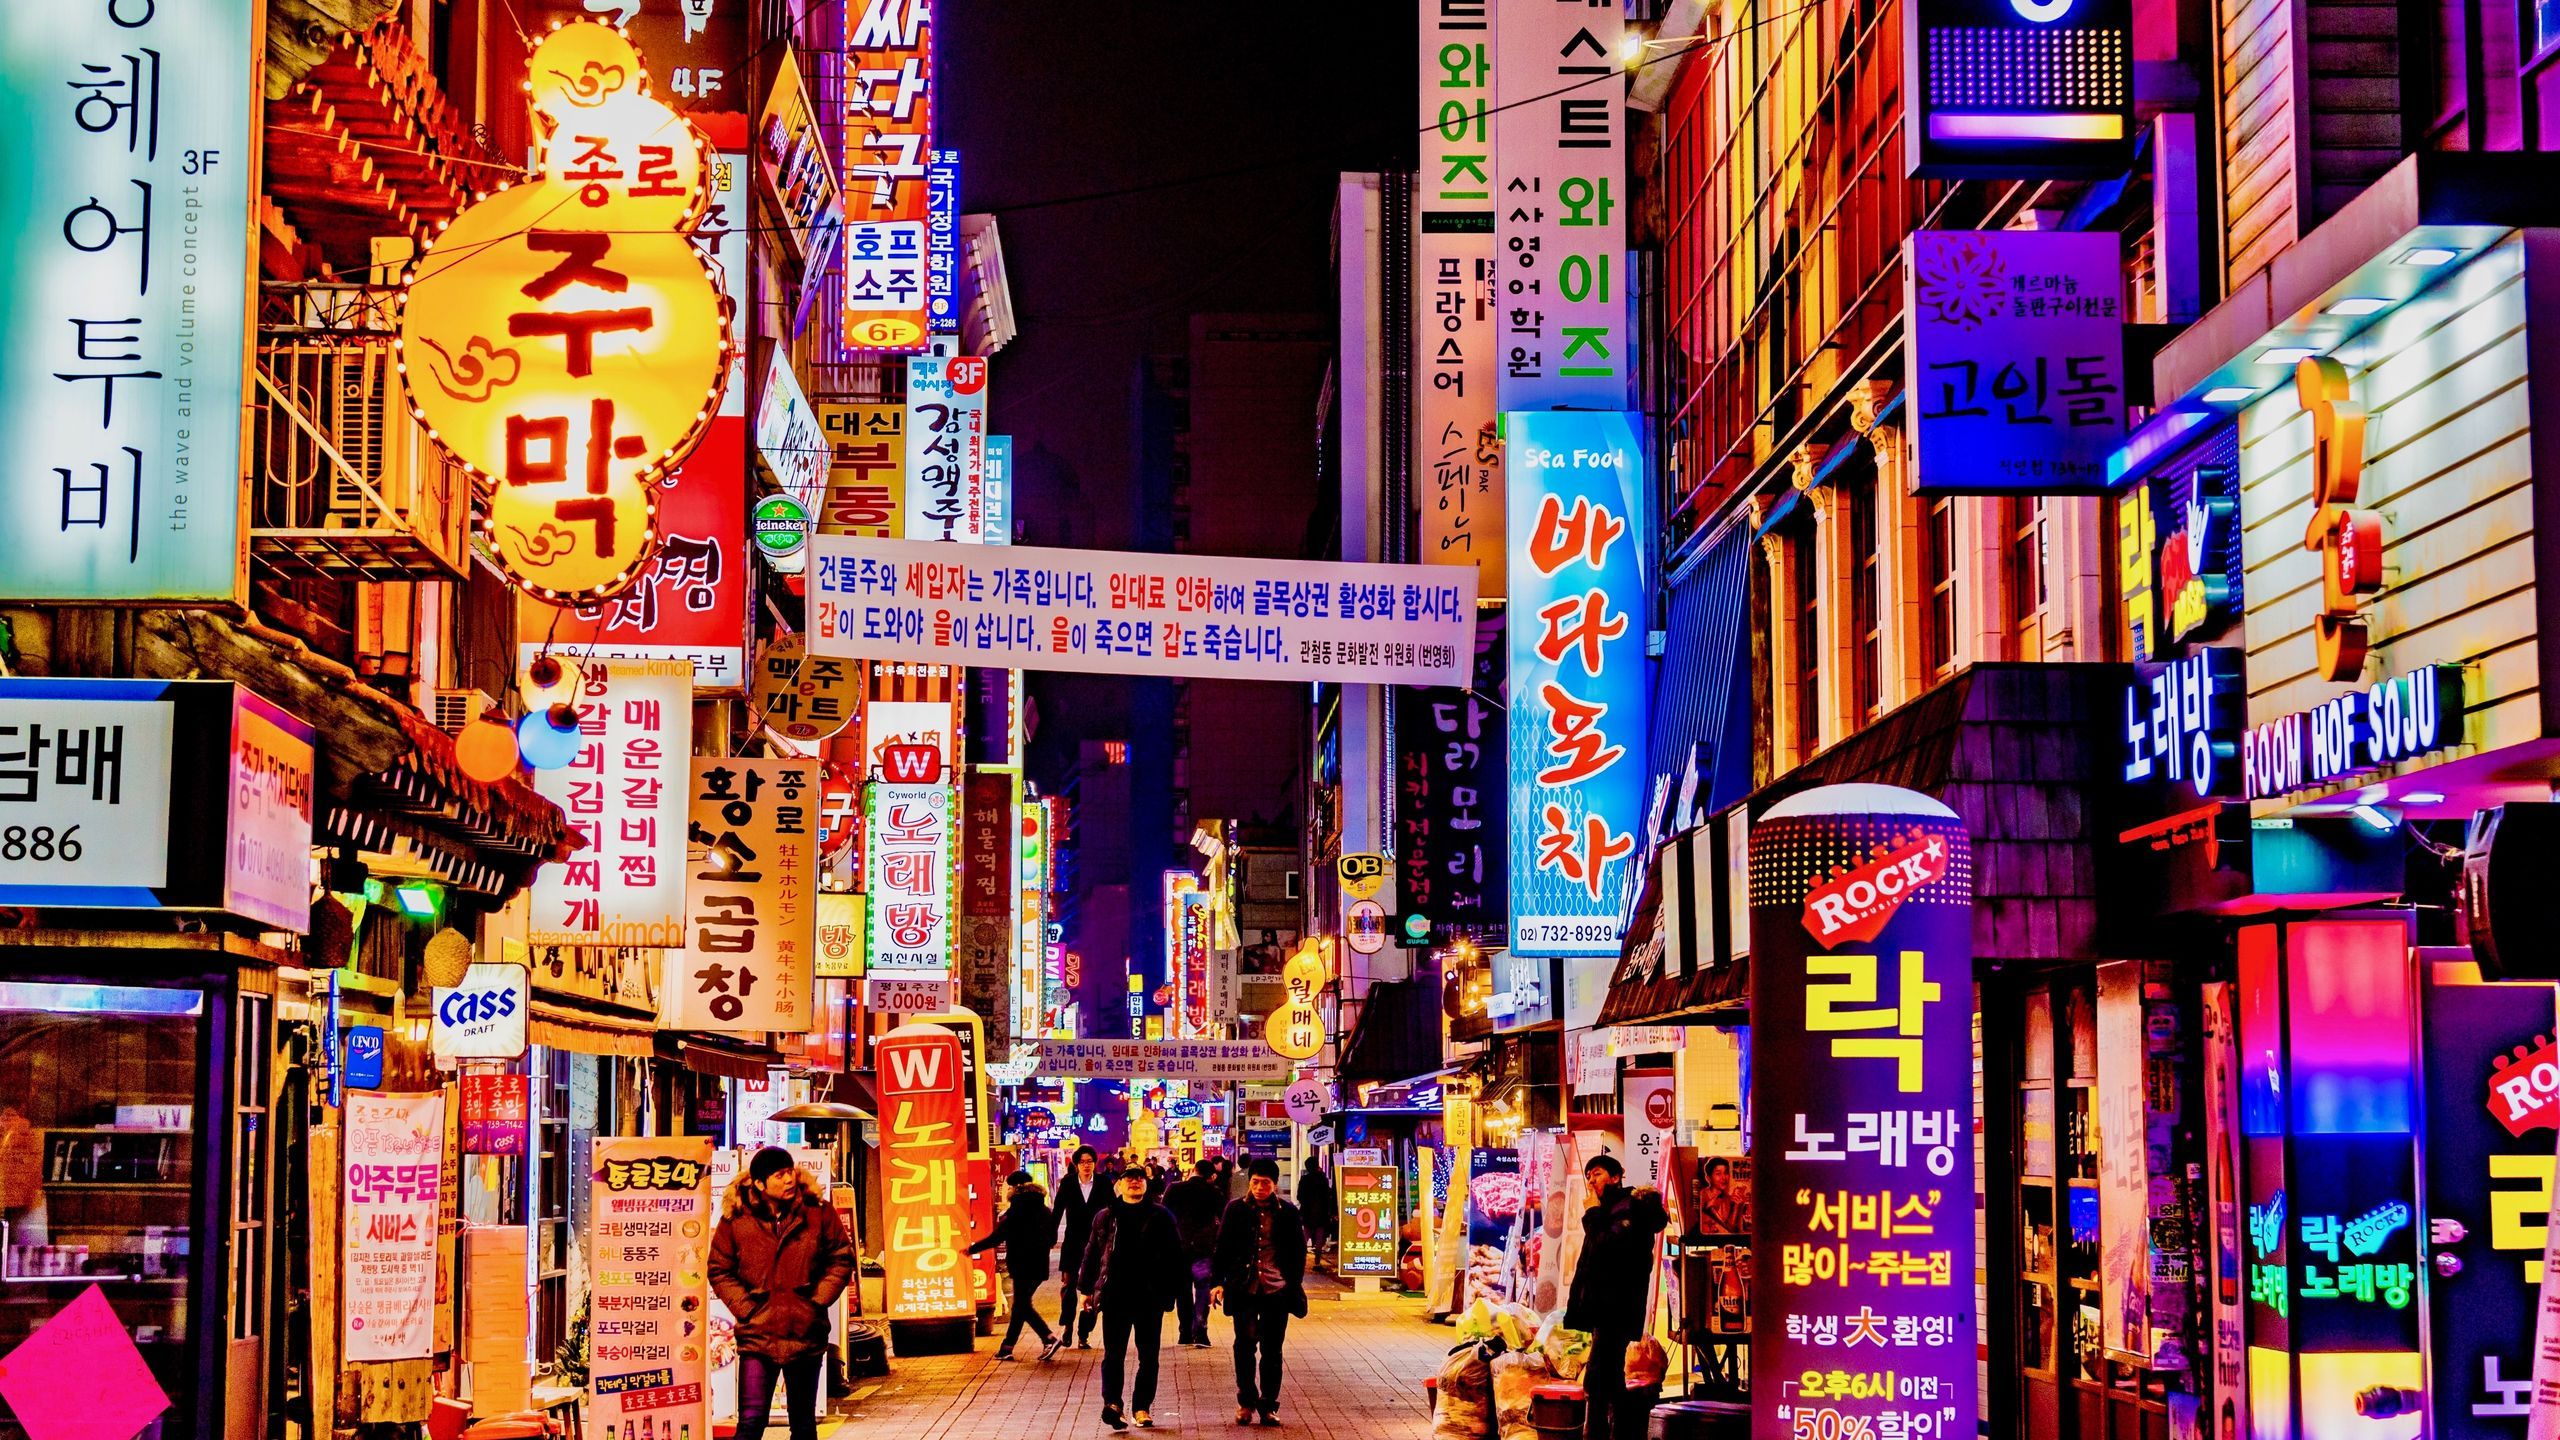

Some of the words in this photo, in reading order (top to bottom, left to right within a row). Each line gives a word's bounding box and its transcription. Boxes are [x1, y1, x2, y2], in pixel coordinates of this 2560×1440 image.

[671, 67, 724, 98] 4F
[850, 0, 931, 208] 싸다구
[181, 150, 220, 175] 3F
[564, 135, 686, 208] 종로
[183, 185, 201, 277] concept
[853, 227, 919, 261] 호프
[929, 168, 954, 297] 국가정보학원
[852, 269, 918, 304] 소주
[1507, 177, 1545, 378] 시사영어학원
[2011, 274, 2079, 295] 게르마늄
[179, 279, 196, 367] volume
[2012, 296, 2119, 318] 돌판구이전문
[868, 322, 907, 342] 6F
[1434, 258, 1466, 397] 프랑스어
[912, 362, 938, 379] 맥주
[912, 379, 955, 398] 야시장
[953, 363, 984, 385] 3F
[178, 378, 193, 418] and
[505, 228, 653, 559] 주막
[1922, 356, 2118, 427] 고인돌
[825, 411, 901, 436] 대신
[175, 438, 191, 485] wave
[1524, 448, 1566, 469] Sea
[1572, 448, 1624, 469] Food
[1433, 420, 1471, 553] 스페인어
[170, 494, 187, 532] the
[819, 554, 898, 598] 건물주와
[905, 561, 984, 603] 세입자는
[993, 566, 1097, 610] 가족입니다.
[1109, 572, 1166, 611] 임대료
[1176, 575, 1246, 616] 인하하여
[1252, 579, 1330, 619] 골목상권
[1338, 581, 1396, 622] 활성화
[1402, 584, 1463, 624] 합시다.
[2119, 484, 2156, 660] 락
[818, 601, 854, 641] 갑이
[862, 605, 924, 646] 도와야
[932, 607, 969, 649] 을이
[974, 612, 1042, 653] 삽니다.
[1050, 615, 1087, 655] 을이
[1094, 618, 1153, 658] 죽으면
[1299, 639, 1332, 666] 관철동
[1336, 641, 1379, 667] 문화발전
[1383, 643, 1415, 668] 위원회
[1418, 644, 1456, 669] (번영회)
[767, 657, 845, 689] 맥주
[766, 693, 842, 722] 마트
[1528, 492, 1635, 902] 바다포차
[2125, 646, 2215, 798] 노래방
[2243, 712, 2302, 801] ROOM
[2310, 693, 2357, 781] HOF
[2366, 662, 2441, 763] SOJU
[893, 751, 931, 778] W
[618, 700, 662, 888] 매운갈비찜
[775, 769, 805, 834] 종로
[888, 790, 927, 802] Cyworld
[1432, 697, 1489, 884] 닭모리
[973, 808, 999, 897] 해물떡찜
[1342, 856, 1381, 875] OB
[693, 766, 768, 1021] 황소곱창
[880, 803, 944, 949] 노래방
[1809, 850, 1934, 936] ROCK
[1859, 896, 1901, 919] MUSIC
[527, 931, 594, 946] steamed
[1520, 928, 1538, 942] 02)
[1541, 924, 1613, 943] 732-8929
[881, 952, 938, 965] 최신시설
[439, 987, 518, 1029] Cass
[1289, 977, 1313, 1049] 월매네
[1804, 950, 1942, 1093] 락
[464, 1024, 496, 1038] DRAFT
[1132, 1017, 1142, 1036] PC
[889, 1048, 943, 1089] W
[1057, 1046, 1107, 1057] 가족입니다.
[1112, 1046, 1139, 1057] 임대료
[488, 1076, 521, 1097] 종로
[1784, 1109, 1961, 1177] 노래방
[349, 1164, 438, 1204] 안주무료
[889, 1101, 962, 1272] 노래방
[1345, 1192, 1392, 1204] 퓨전포차
[366, 1214, 417, 1244] 서비스
[599, 1221, 672, 1237] 크림생막걸리
[1356, 1208, 1377, 1240] 9
[2301, 1215, 2343, 1263] 락
[2351, 1210, 2397, 1247] ROCK
[1343, 1241, 1393, 1252] 호프&소주
[598, 1271, 671, 1286] 청포도막걸리
[901, 1277, 954, 1289] 최신시설
[2250, 1263, 2289, 1319] 노래방
[2300, 1262, 2415, 1309] 노래방
[598, 1295, 671, 1311] 복분자막걸리
[597, 1320, 658, 1336] 포도막걸리
[597, 1345, 670, 1361] 복숭아막걸리
[1798, 1369, 1895, 1402] 오후6시
[1899, 1375, 1939, 1400] 이전
